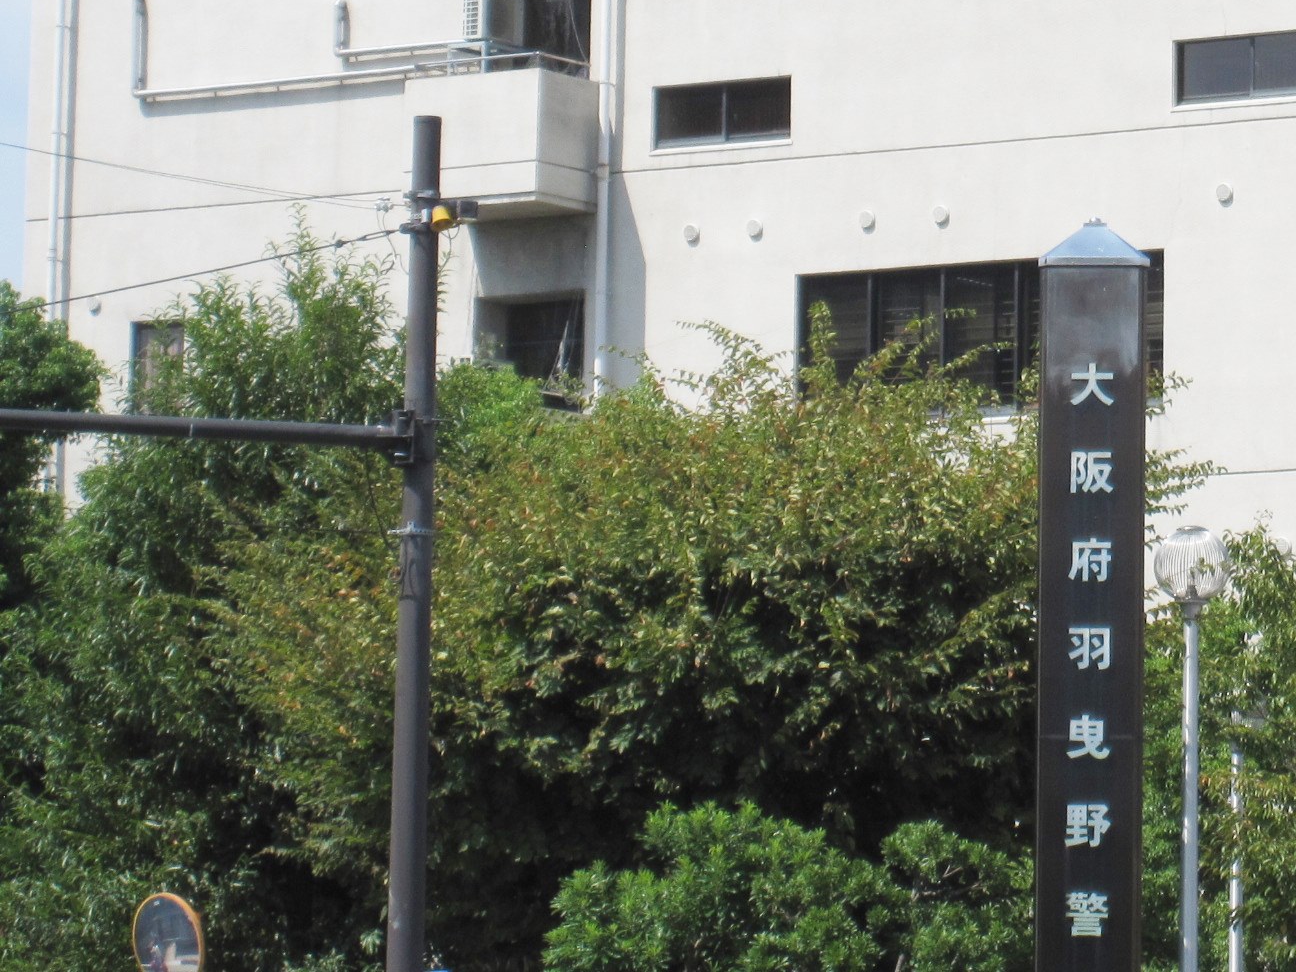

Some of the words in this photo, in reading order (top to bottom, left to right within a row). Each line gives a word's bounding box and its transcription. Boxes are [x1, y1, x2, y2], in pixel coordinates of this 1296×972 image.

[1064, 362, 1114, 937] 大阪府羽曳野警
